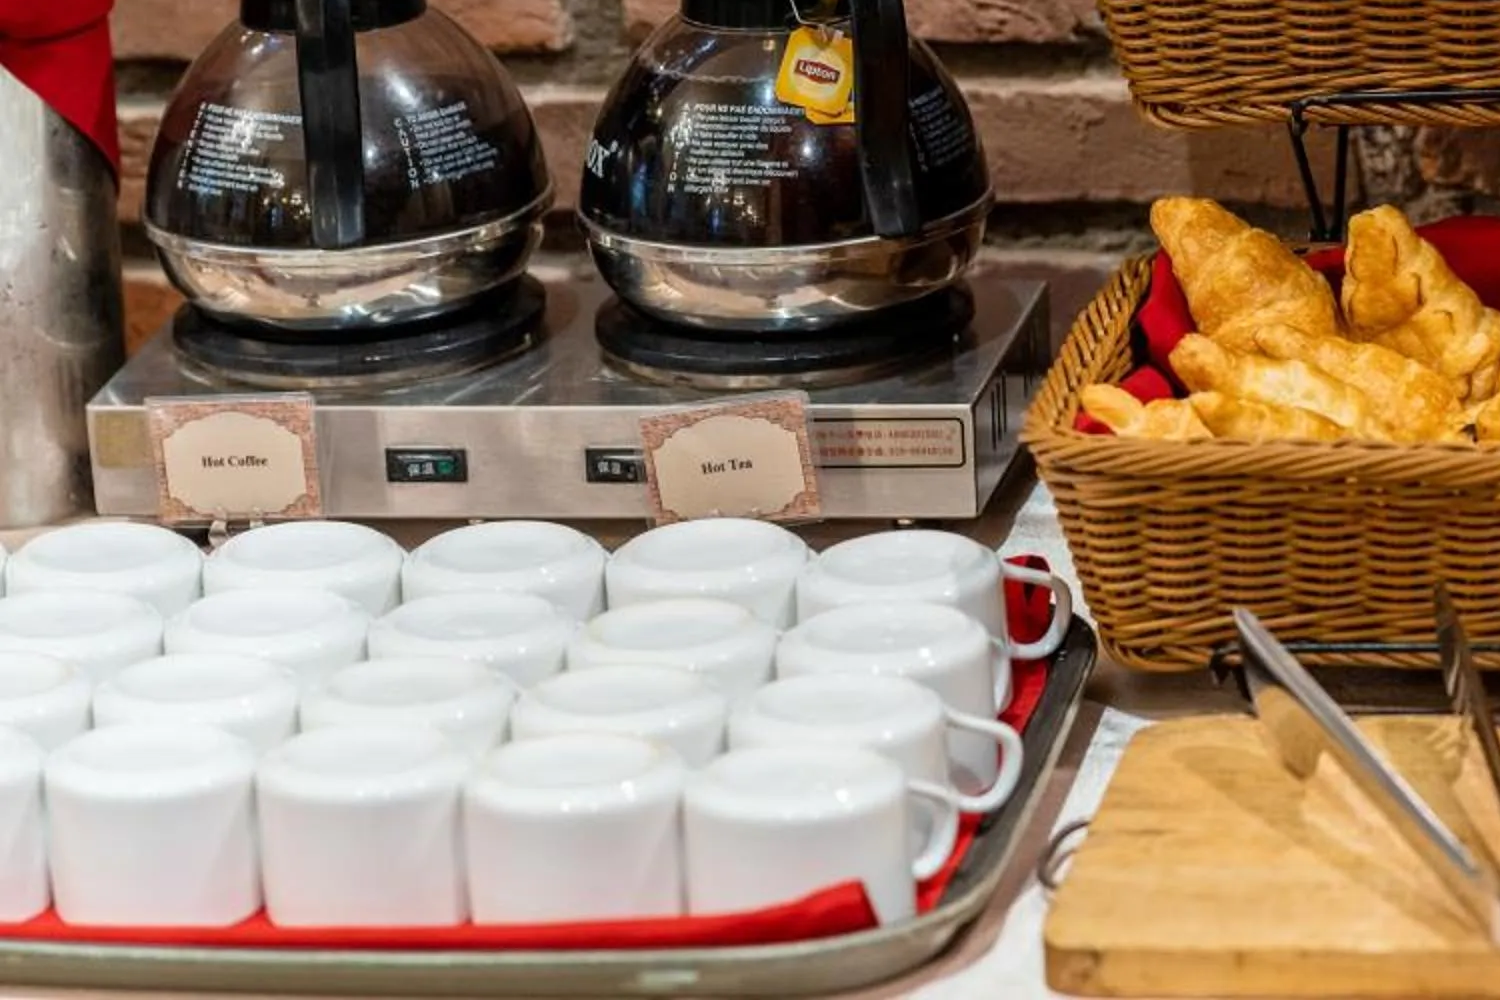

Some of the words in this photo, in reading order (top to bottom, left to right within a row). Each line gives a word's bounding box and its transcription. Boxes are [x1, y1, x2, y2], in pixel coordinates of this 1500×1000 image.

[799, 60, 836, 81] Lipton
[201, 455, 225, 469] Hot
[227, 455, 269, 469] Coffee
[701, 462, 726, 475] Hot
[728, 459, 753, 471] Tea
